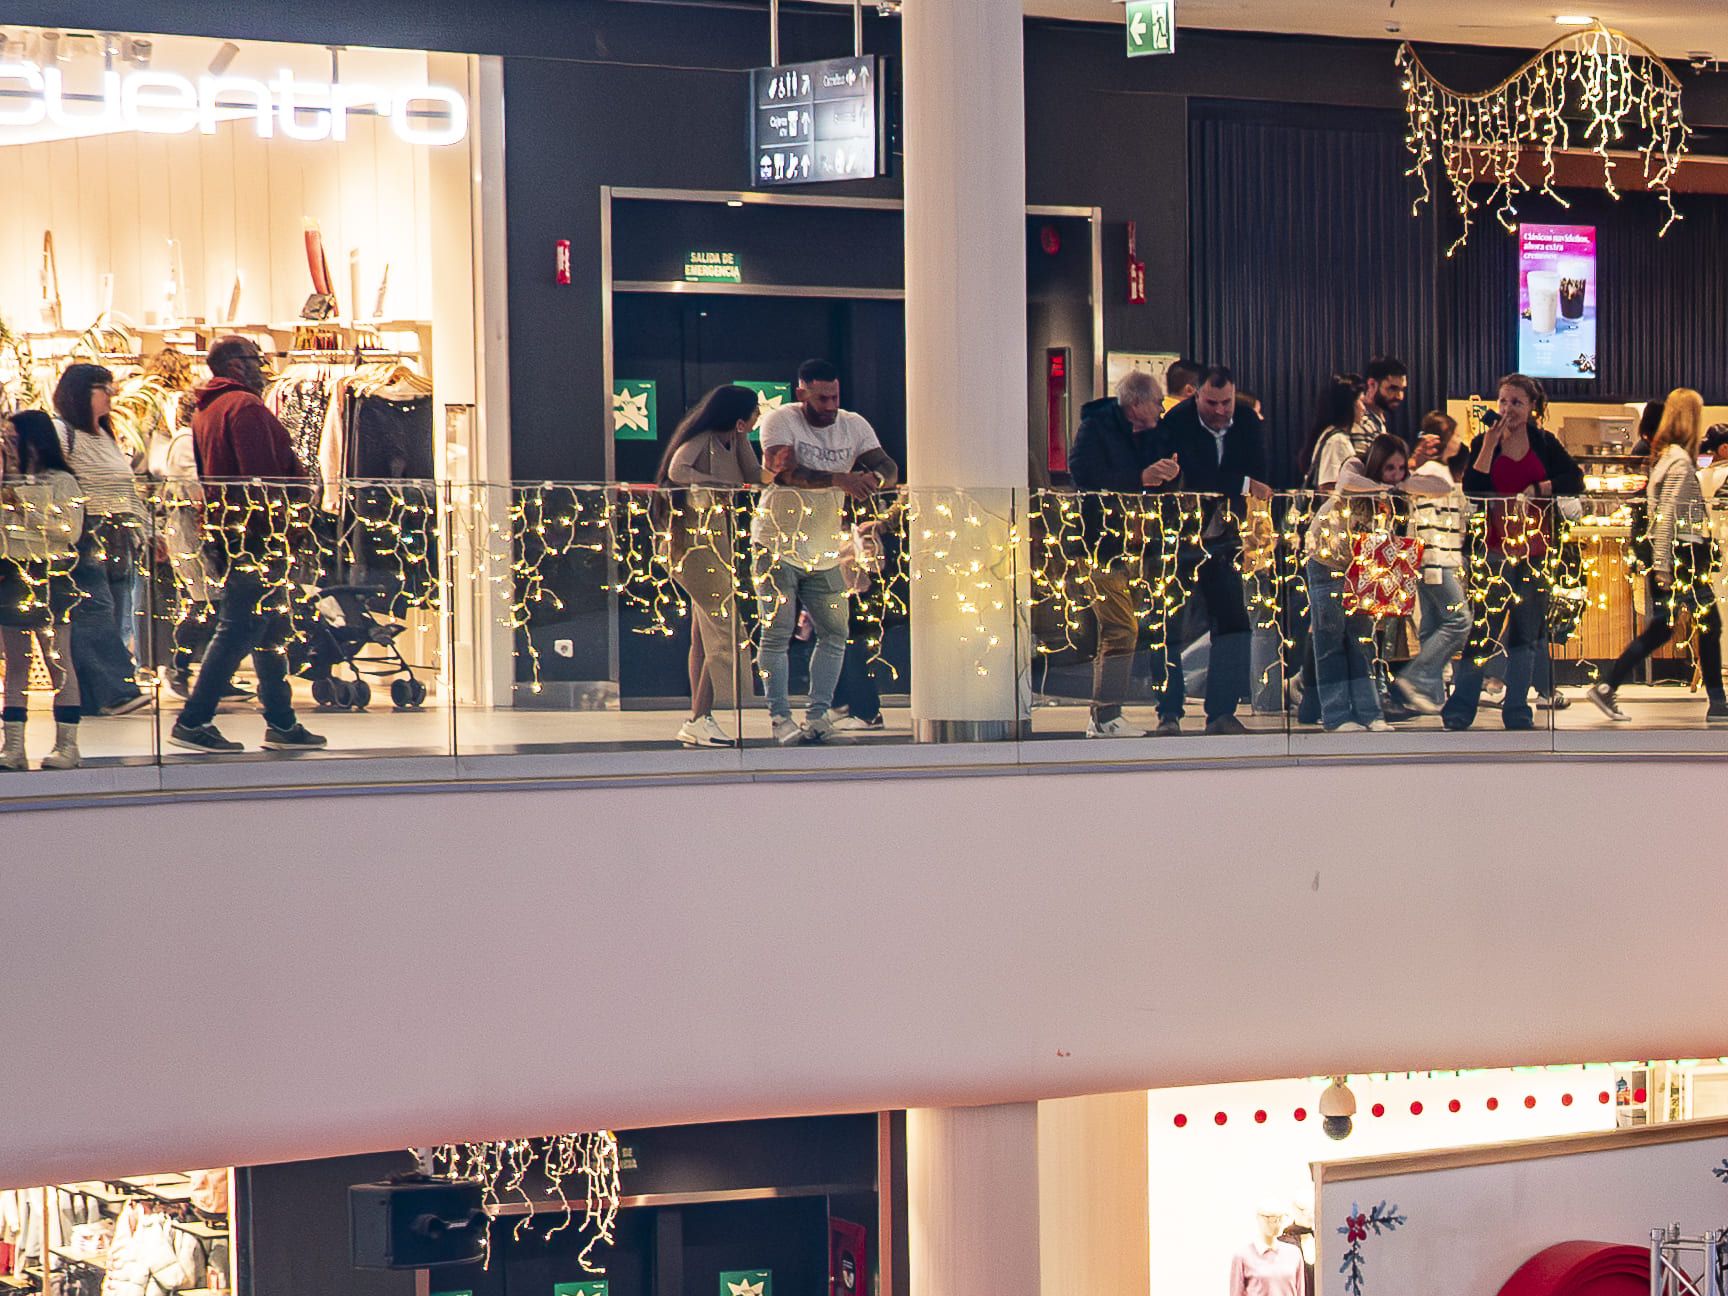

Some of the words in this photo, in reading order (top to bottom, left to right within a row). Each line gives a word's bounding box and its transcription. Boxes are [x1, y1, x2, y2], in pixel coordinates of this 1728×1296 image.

[691, 252, 720, 264] SALIDA
[722, 253, 734, 265] DE
[685, 265, 740, 278] EMERGENCIA
